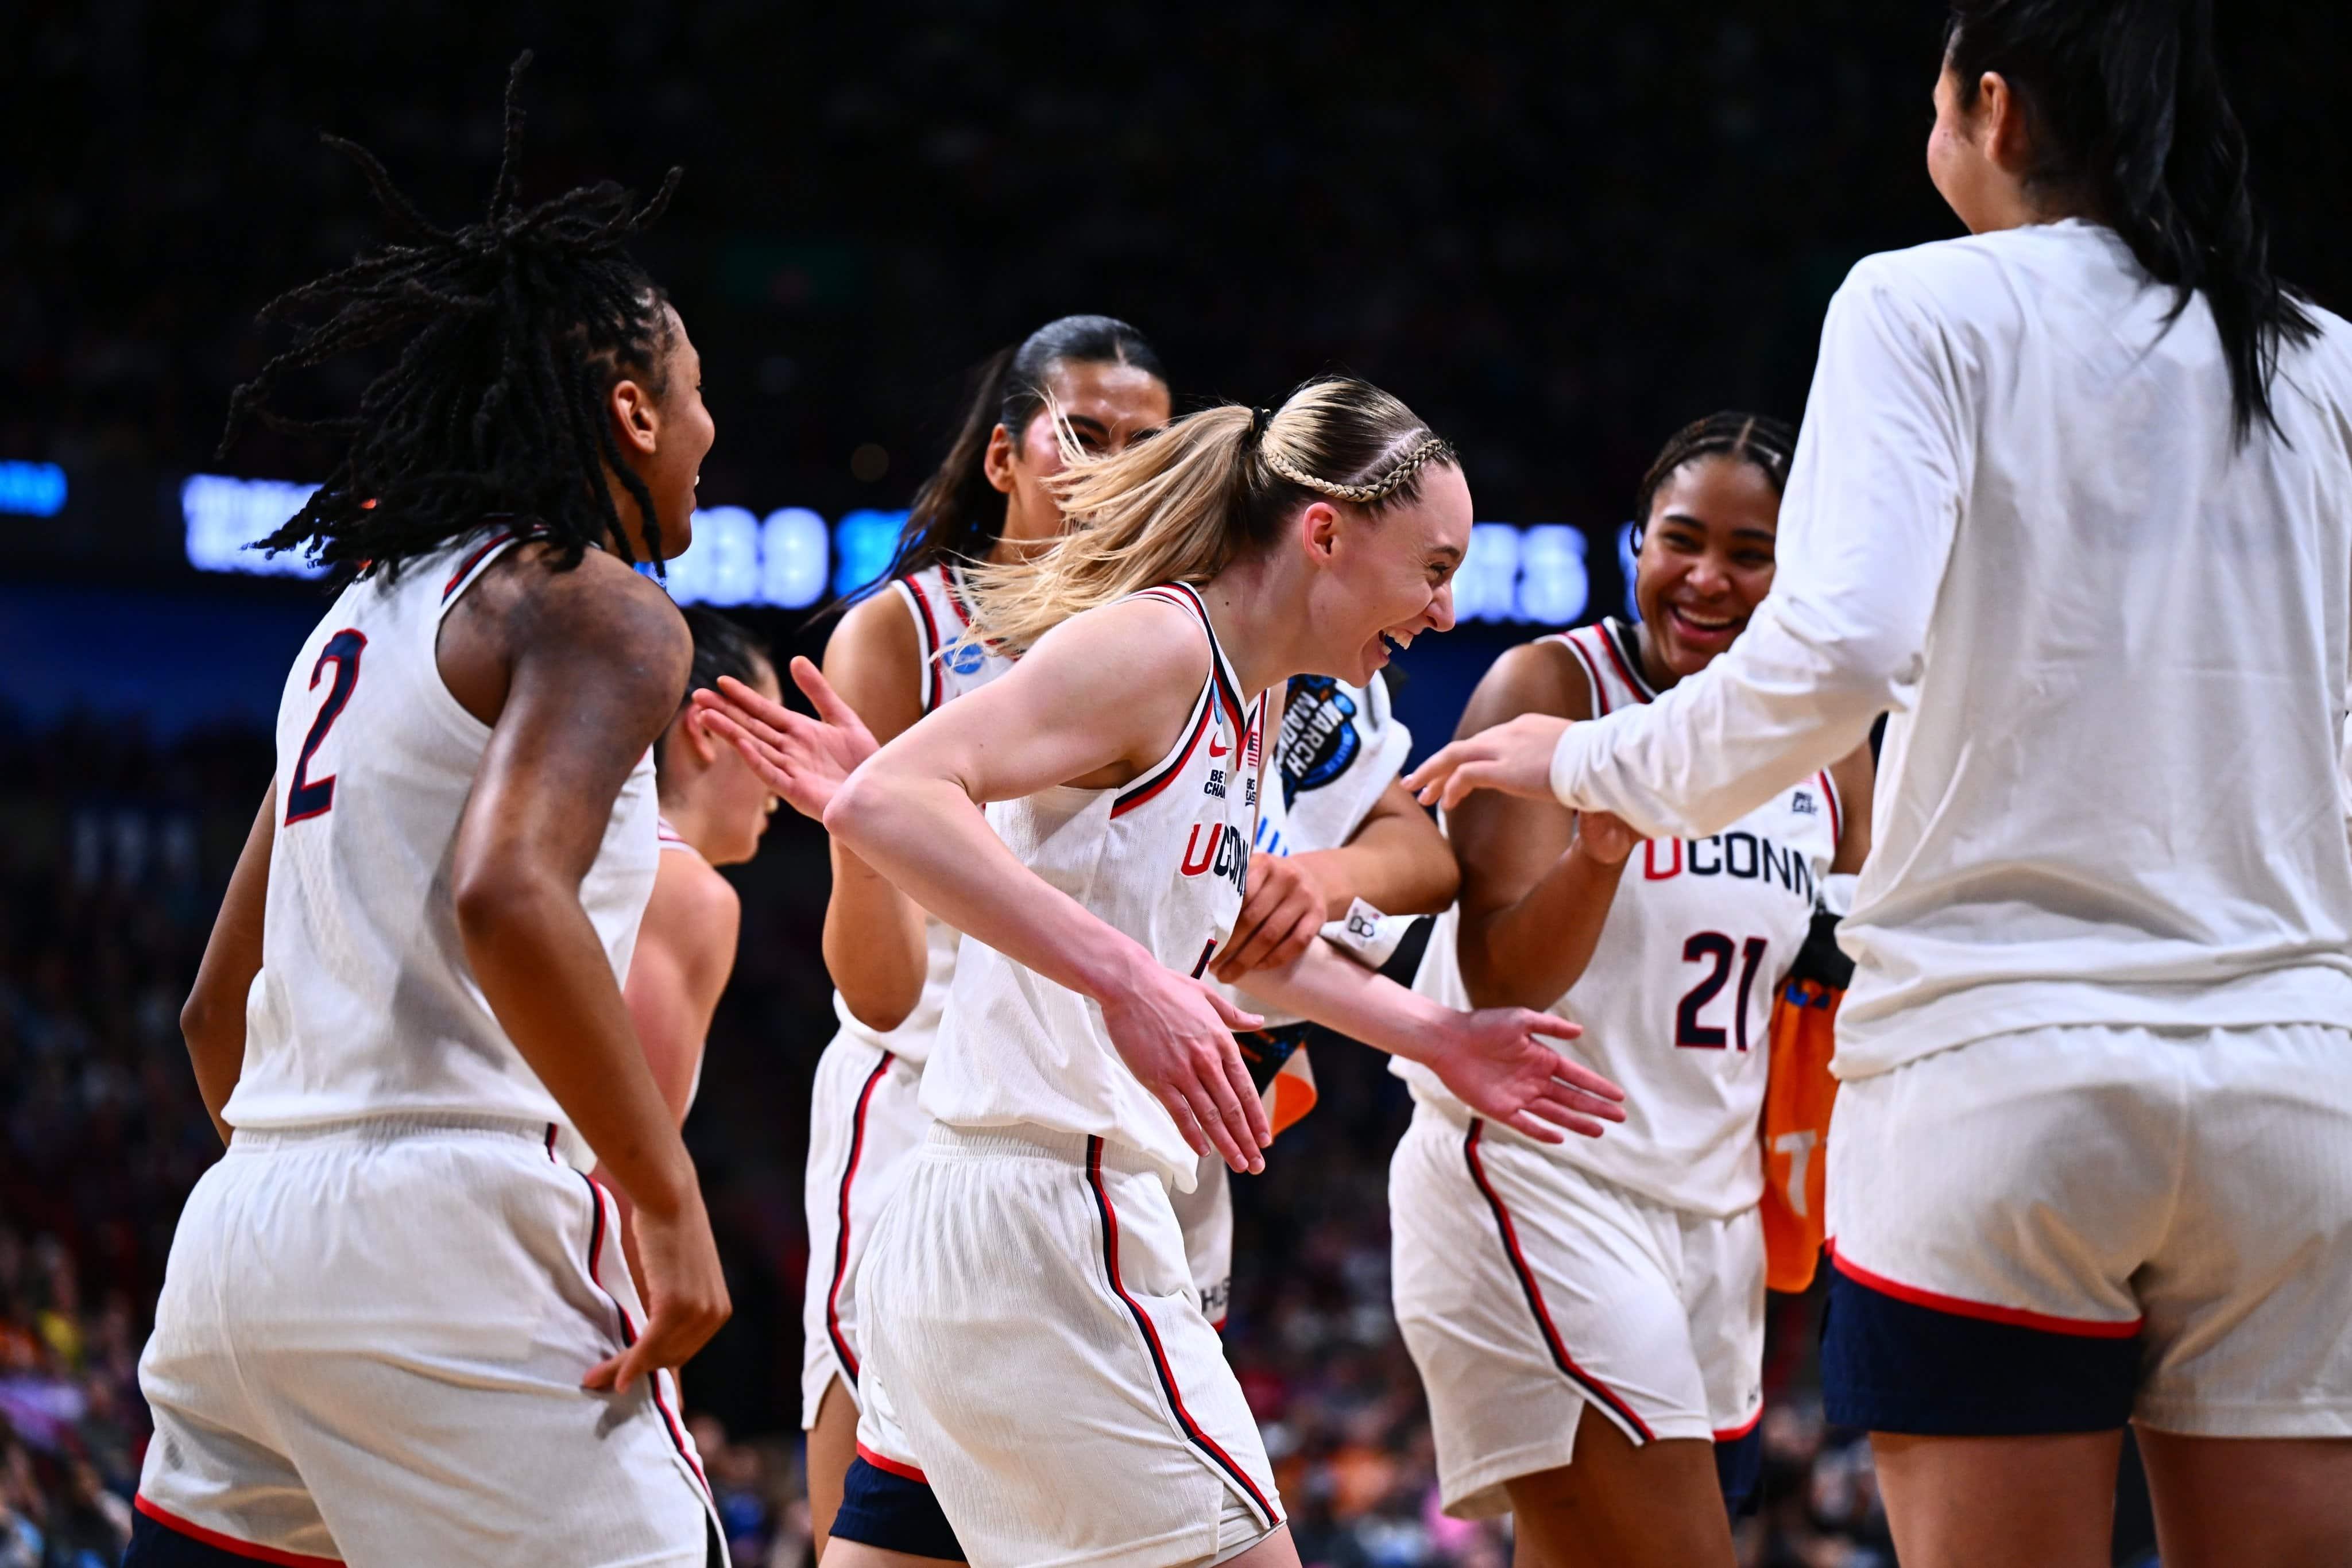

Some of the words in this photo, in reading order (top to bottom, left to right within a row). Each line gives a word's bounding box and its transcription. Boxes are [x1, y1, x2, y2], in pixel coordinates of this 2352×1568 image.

[284, 628, 368, 827] 2
[1286, 699, 1344, 778] MARCH
[1210, 769, 1224, 783] BE
[1245, 790, 1256, 802] EAS
[1645, 831, 1813, 905] UCONN
[1675, 930, 1768, 1052] 21
